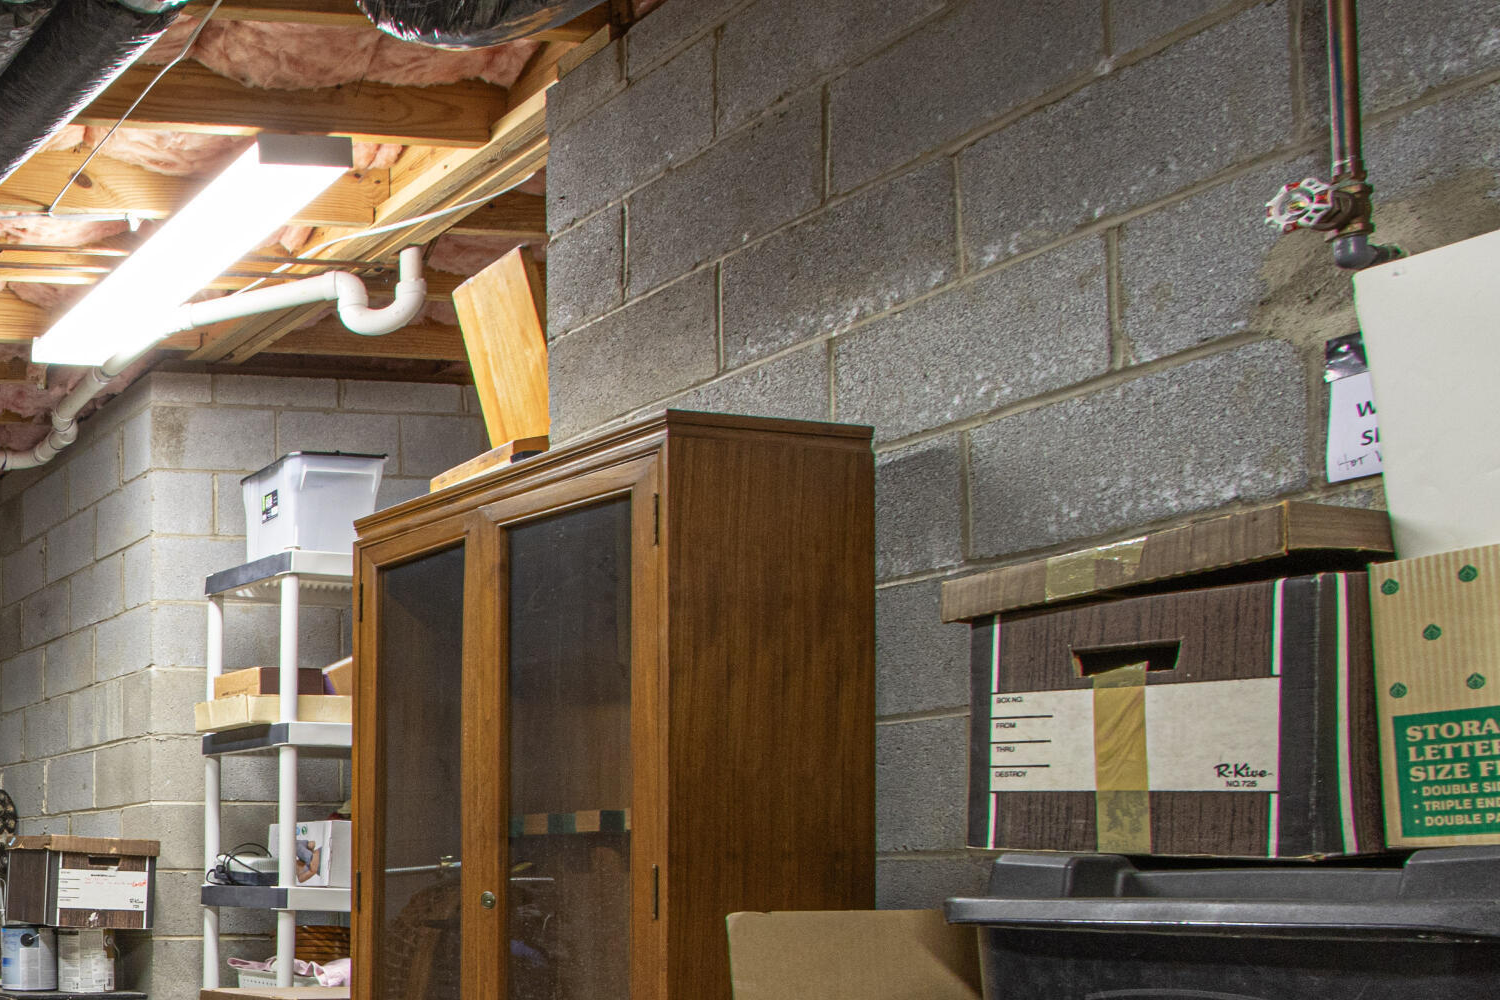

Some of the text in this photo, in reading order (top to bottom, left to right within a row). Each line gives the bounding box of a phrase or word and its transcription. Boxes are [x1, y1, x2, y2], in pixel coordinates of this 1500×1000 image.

[1409, 763, 1470, 782] SIZE
[1422, 783, 1478, 796] DOUBLE
[1422, 799, 1472, 811] TRIPLE
[1425, 814, 1481, 827] DOUBLE
